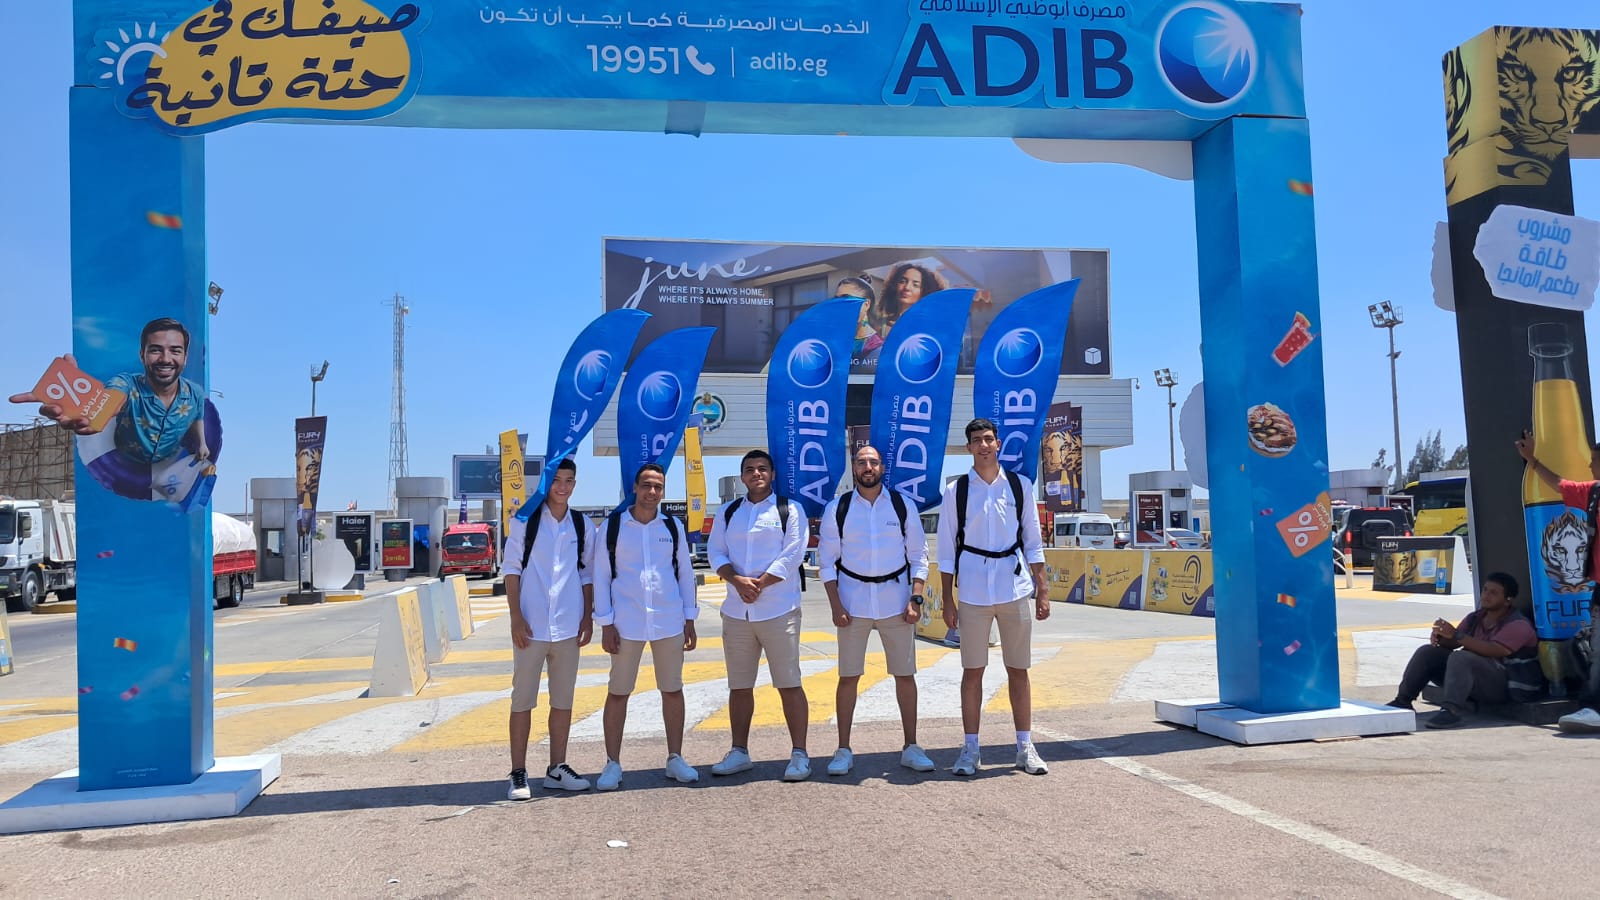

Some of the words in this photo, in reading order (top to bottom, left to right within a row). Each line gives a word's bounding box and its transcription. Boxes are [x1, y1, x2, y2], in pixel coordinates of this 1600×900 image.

[479, 5, 538, 25] تكون
[542, 6, 563, 26] أن
[566, 11, 623, 30] يجب
[627, 12, 673, 28] كما
[677, 12, 776, 32] المصرفية
[1073, 0, 1126, 21] مصرف
[183, 0, 233, 57] في
[242, 0, 420, 48] صيفك
[780, 19, 870, 35] الخدمات
[586, 44, 680, 75] 19951
[749, 52, 828, 77] adib.eg
[892, 22, 1134, 100] ADIB
[126, 55, 273, 126] تانية
[285, 56, 405, 101] حتة
[1517, 218, 1572, 245] مشروب
[1518, 244, 1568, 271] طاقة
[658, 285, 688, 294] WHERE
[690, 286, 705, 295] IT'S
[706, 287, 738, 296] ALWAYS
[739, 288, 766, 297] HOME,
[1539, 275, 1580, 299] بطعم
[658, 295, 688, 304] WHERE
[690, 296, 705, 305] IT'S
[706, 296, 738, 305] ALWAYS
[740, 297, 775, 306] SUMMER
[297, 431, 321, 441] FURY
[999, 387, 1037, 472] DIB
[798, 399, 830, 506] ADIB
[894, 395, 933, 503] ADIB
[665, 503, 687, 512] Haier
[342, 516, 366, 525] Haier
[1381, 541, 1399, 550] FURY
[1546, 600, 1592, 624] FUR
